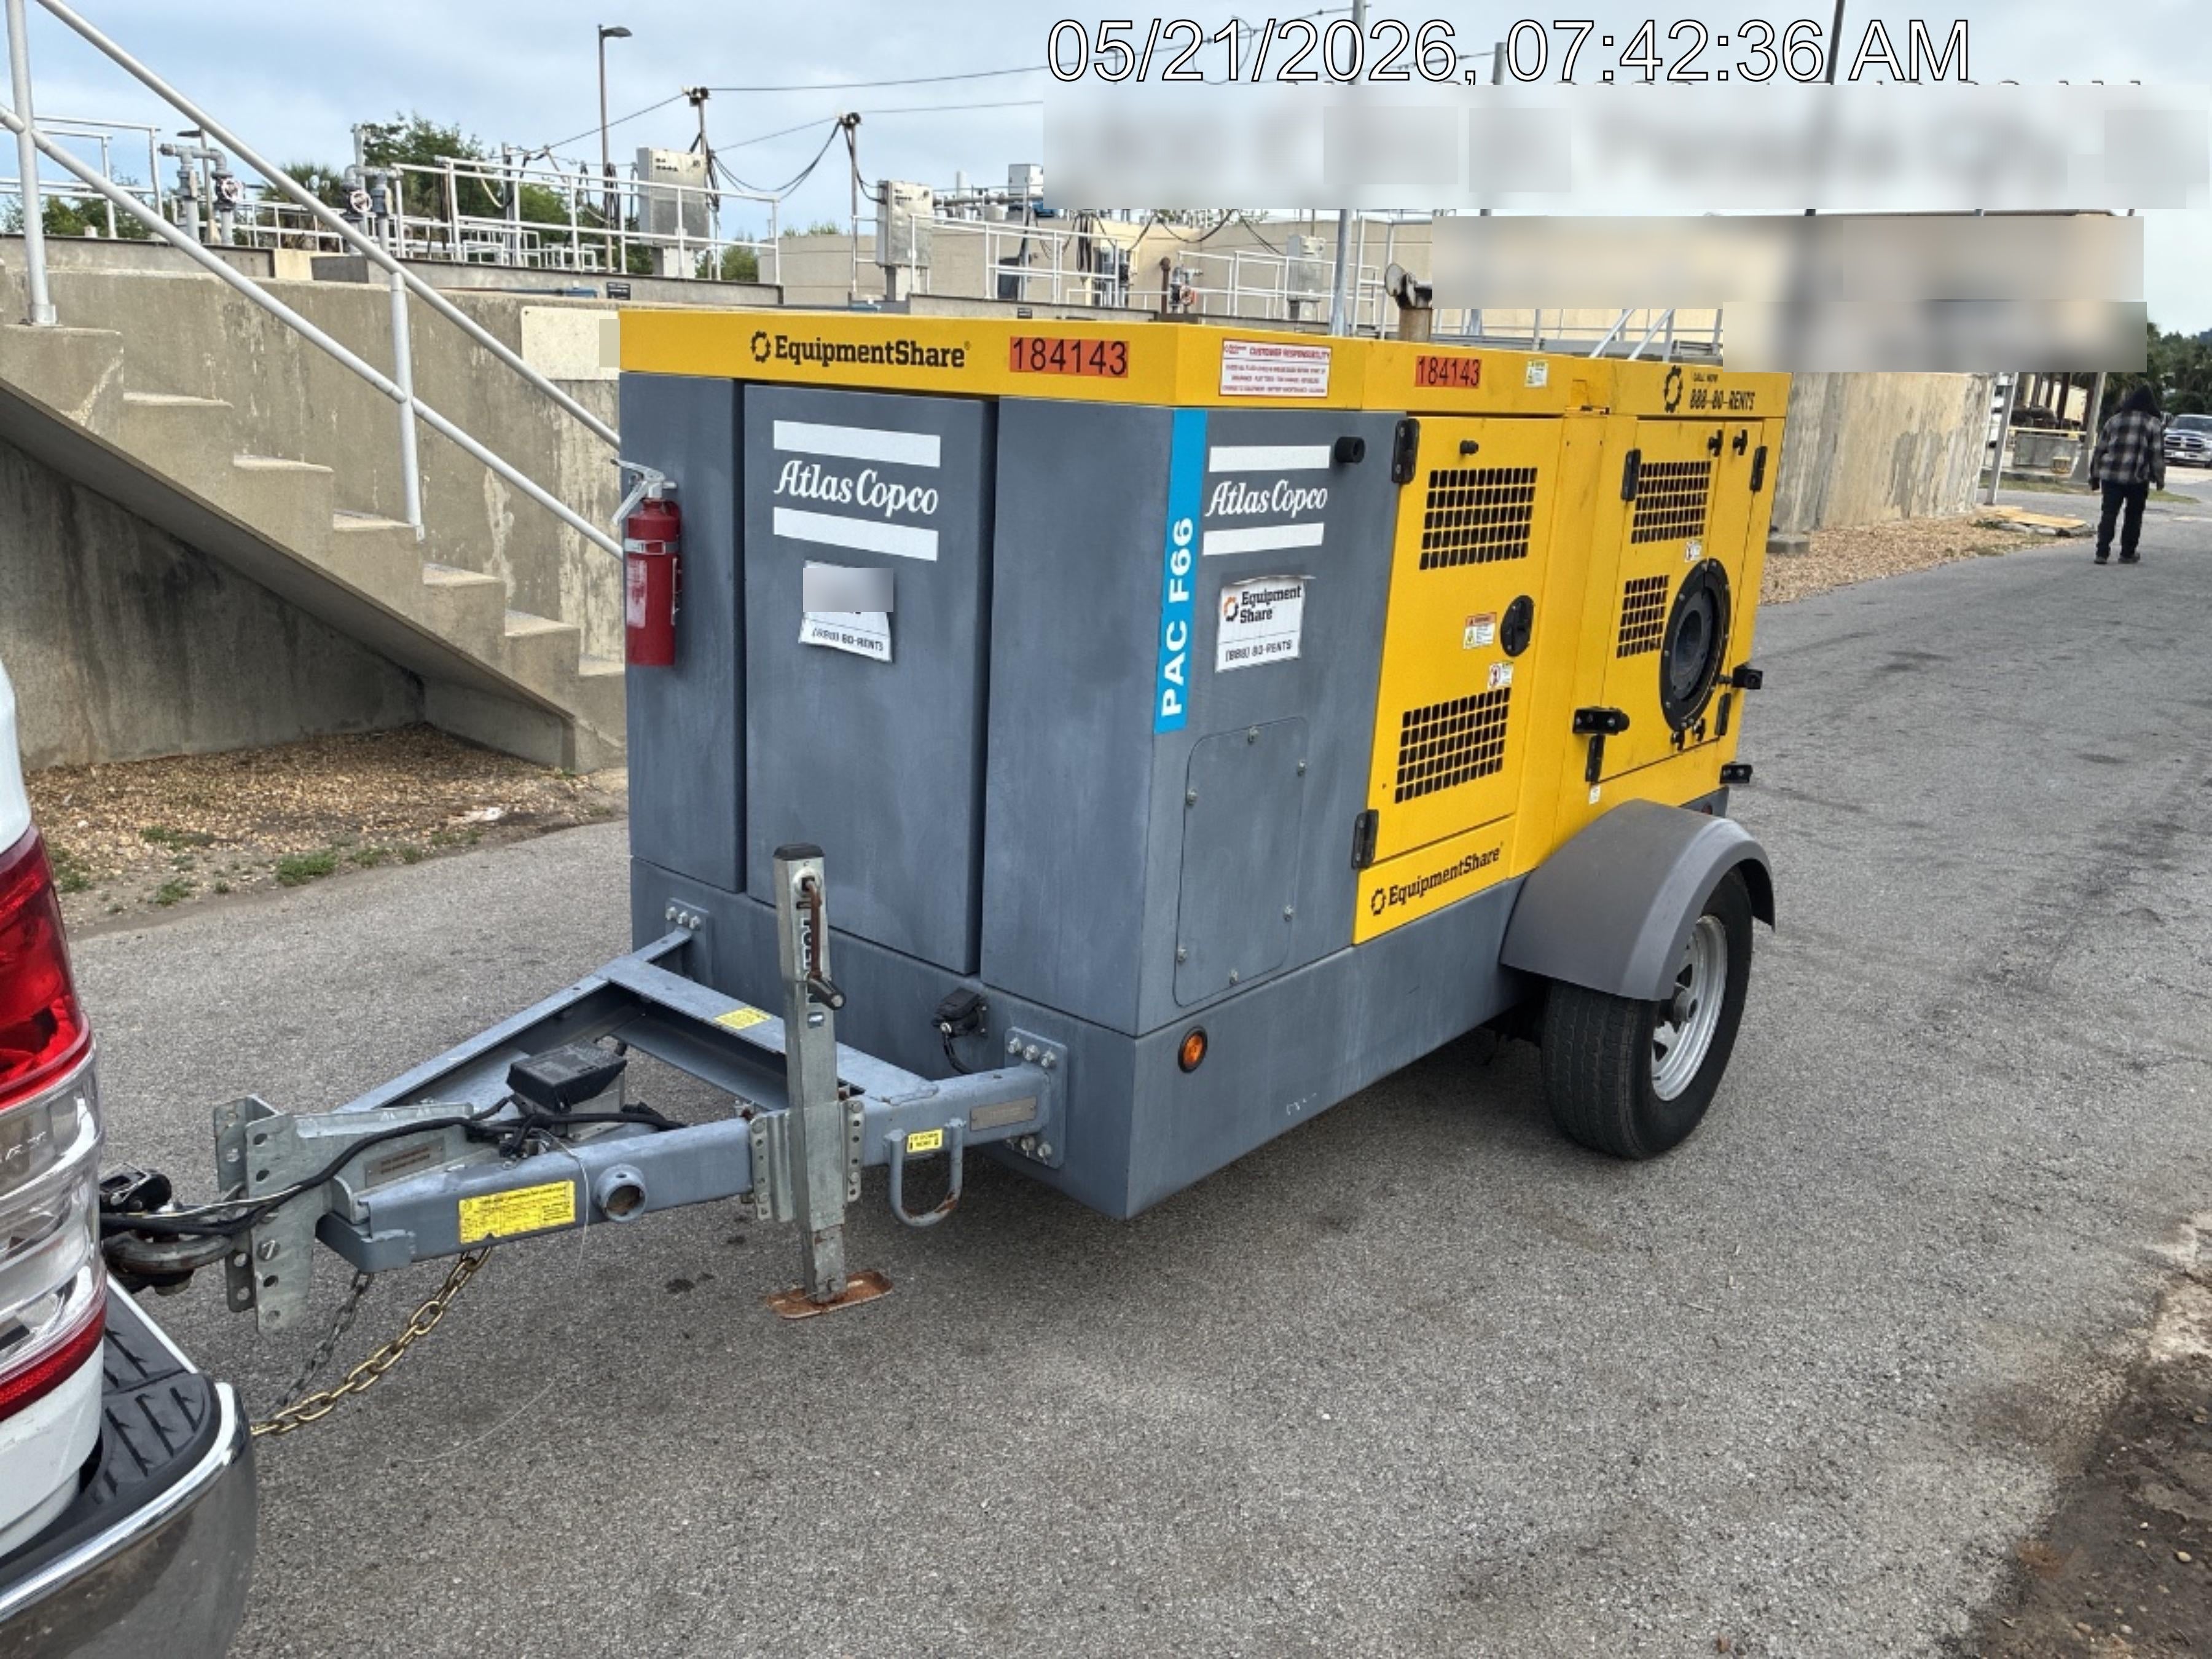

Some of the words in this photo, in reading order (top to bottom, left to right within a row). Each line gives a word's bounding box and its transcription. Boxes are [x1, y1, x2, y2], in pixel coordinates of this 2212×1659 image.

[1013, 337, 1128, 375] 184143
[1419, 357, 1480, 386] 184143
[774, 460, 853, 503] Atlas
[857, 468, 938, 517] Copco
[1205, 481, 1269, 517] Atlas
[1272, 479, 1328, 517] Copco
[1169, 517, 1193, 603] F66
[1241, 586, 1301, 608] Equipment
[1241, 607, 1273, 624] Share
[1161, 621, 1188, 717] PAC
